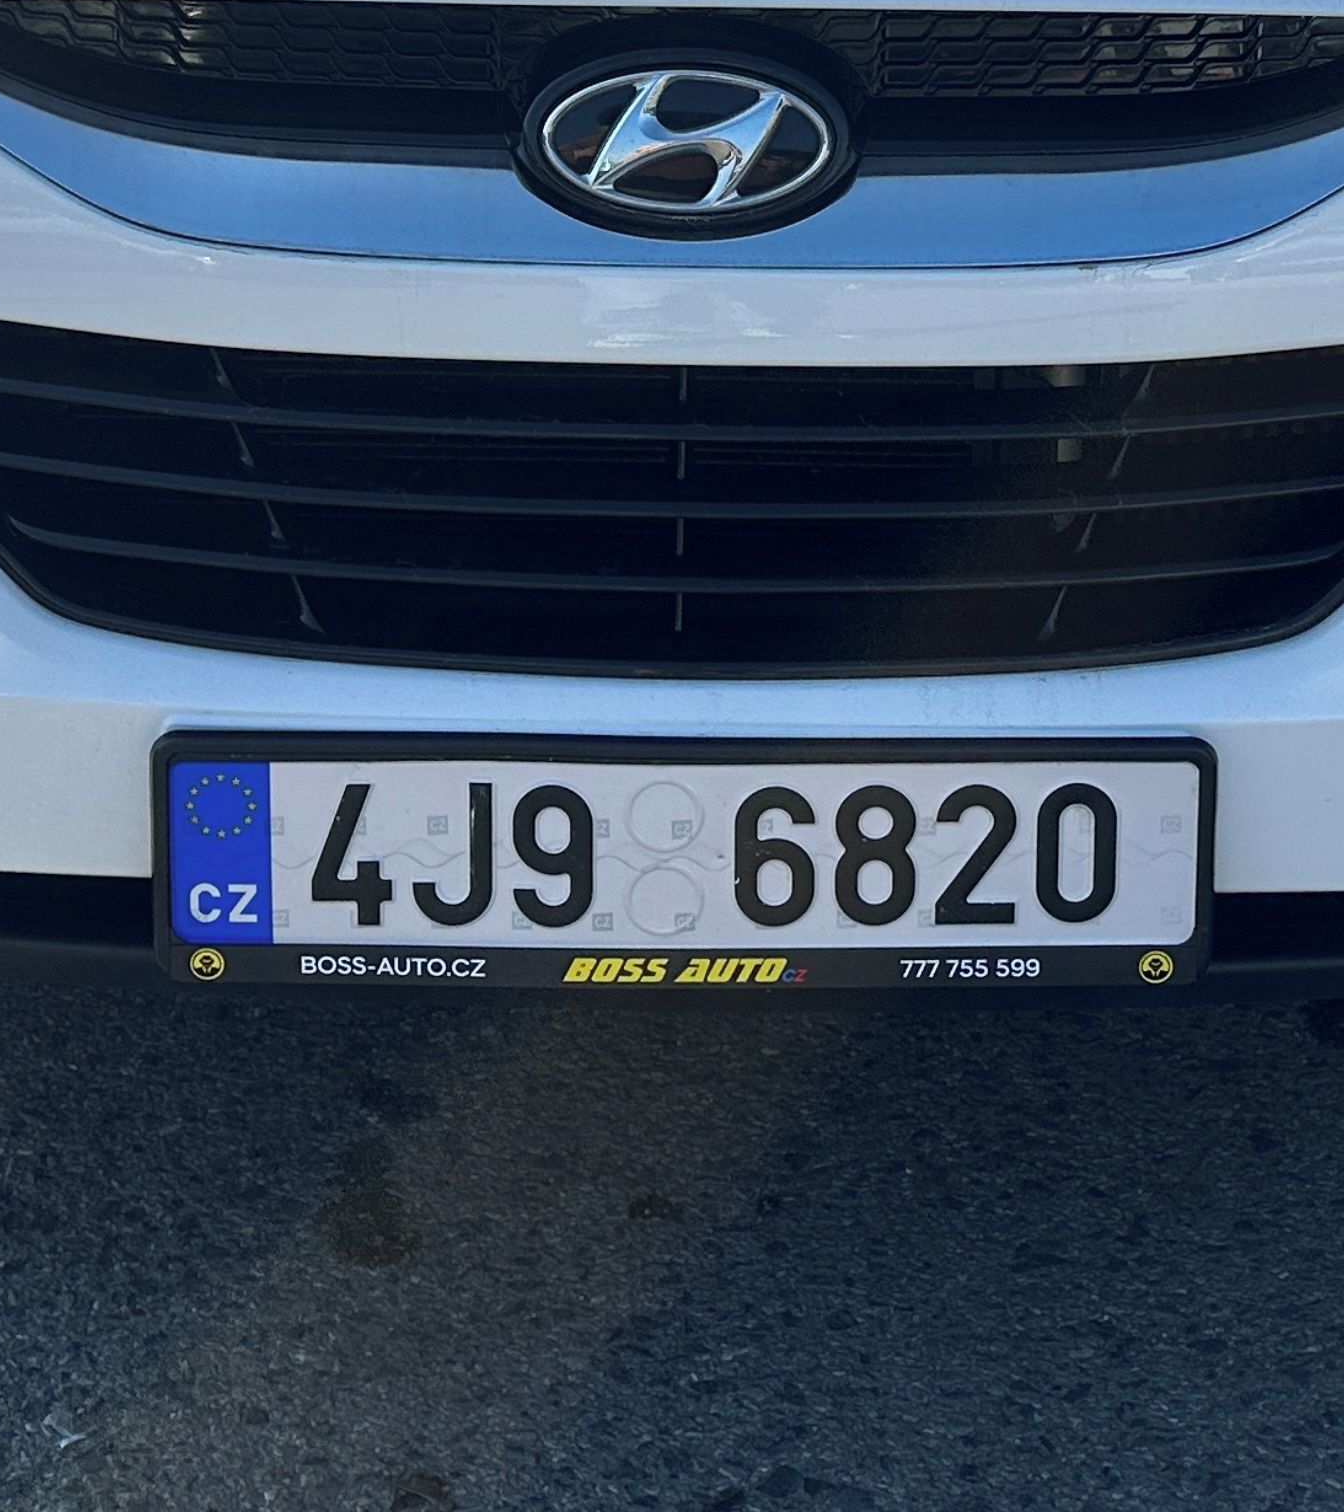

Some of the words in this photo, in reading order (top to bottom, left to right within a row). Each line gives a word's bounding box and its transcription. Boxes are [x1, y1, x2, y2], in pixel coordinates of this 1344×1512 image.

[311, 782, 594, 928] 4J9
[734, 782, 1118, 927] 6820
[189, 882, 258, 923] CZ
[300, 955, 486, 978] BOSS-AUTO.CZ
[562, 957, 670, 983] BOSS
[899, 959, 940, 978] 777
[945, 959, 989, 978] 755
[995, 958, 1041, 977] 599
